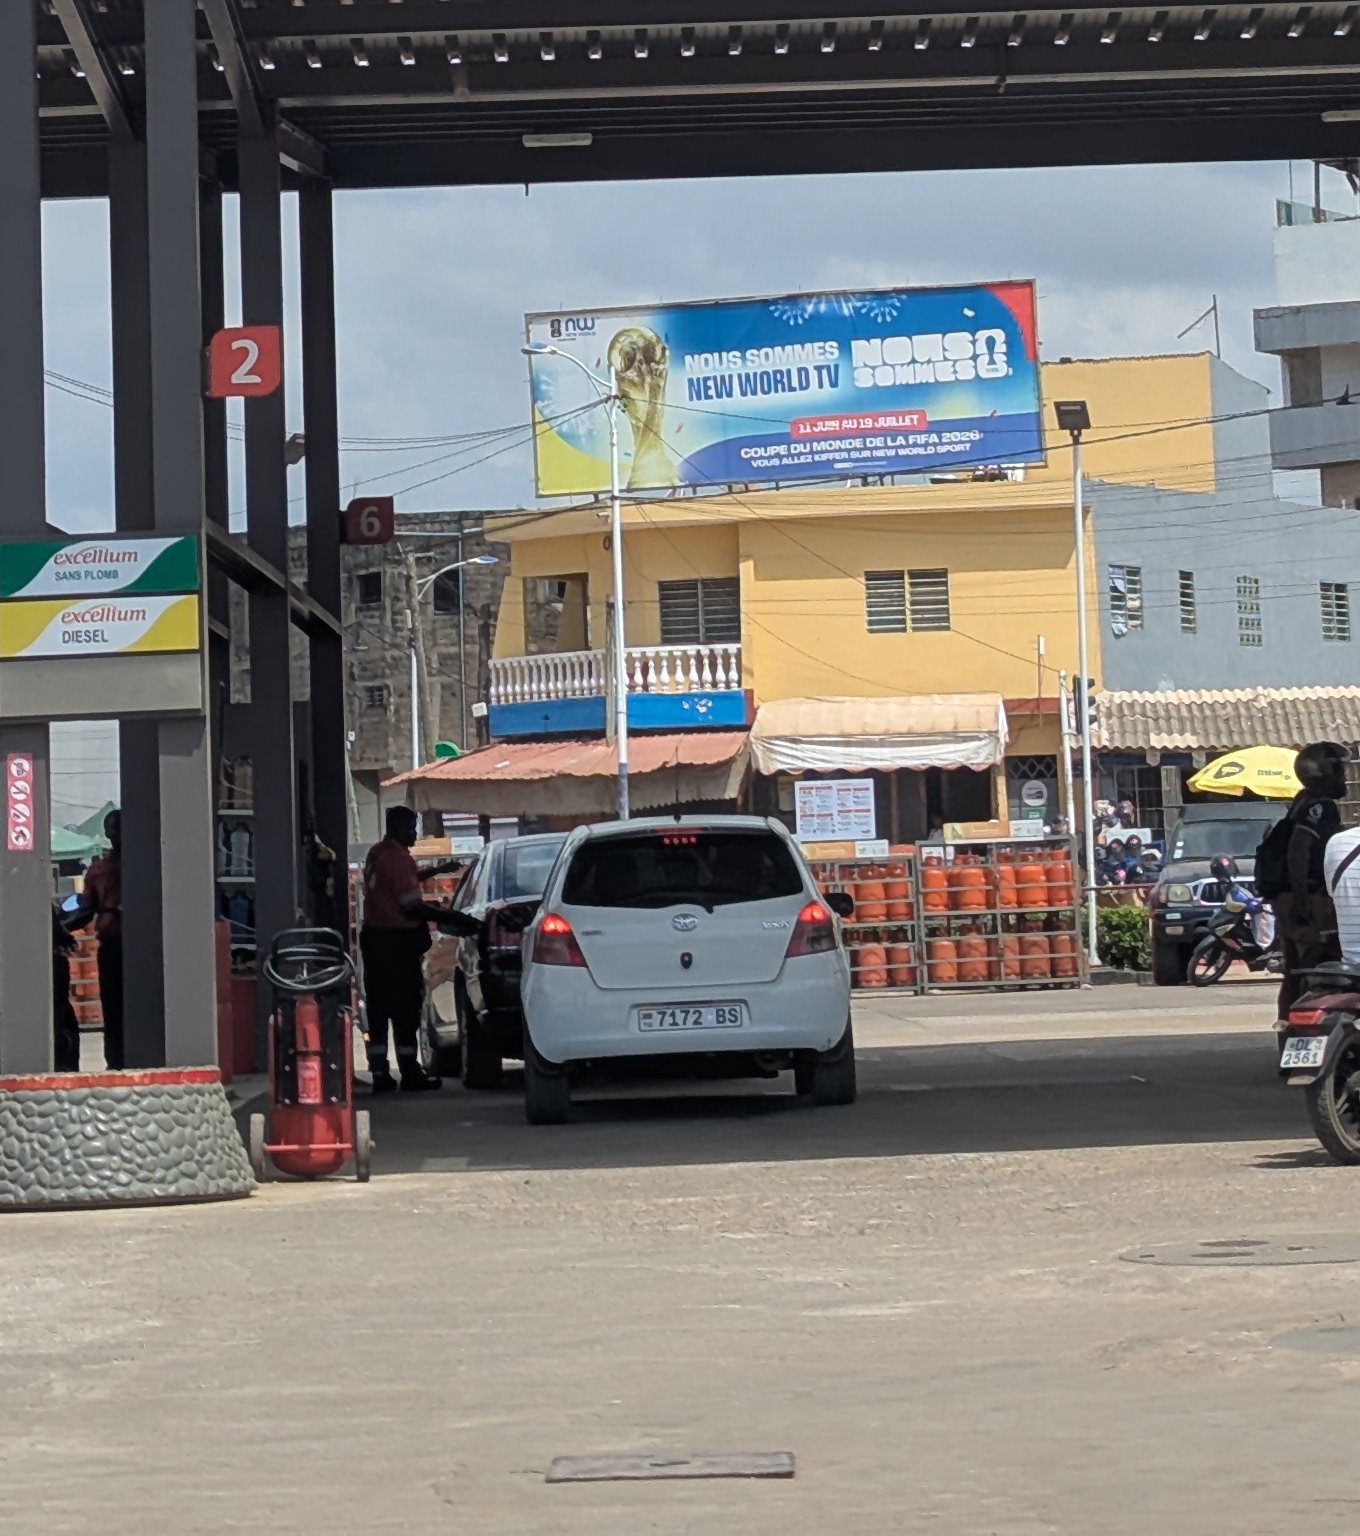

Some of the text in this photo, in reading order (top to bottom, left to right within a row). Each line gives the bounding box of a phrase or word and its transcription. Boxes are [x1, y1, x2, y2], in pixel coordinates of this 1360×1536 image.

[230, 339, 262, 384] 2
[684, 340, 840, 373] NOUS SOMMES
[851, 331, 974, 368] NOUS
[687, 363, 840, 402] NEW WORLD TV
[853, 359, 976, 388] SOMMES
[842, 419, 858, 430] AU
[859, 418, 873, 429] 19
[874, 414, 920, 428] JUILLET
[741, 445, 788, 459] COUPE
[790, 442, 811, 454] DU
[813, 438, 863, 452] MONDE
[866, 436, 885, 448] DE
[887, 435, 907, 446] LA
[908, 432, 939, 445] FIFA
[751, 458, 780, 469] VOUS
[781, 455, 813, 466] ALLEZ
[850, 449, 871, 460] SUR
[872, 448, 897, 458] NEW
[898, 445, 935, 457] WORLD
[359, 501, 382, 537] 6
[53, 549, 138, 565] excellium
[55, 570, 81, 582] SANS
[61, 606, 147, 624] excellium
[62, 629, 109, 644] DIESEL
[656, 1007, 739, 1027] 7172 BS
[1283, 1051, 1318, 1066] 2561
